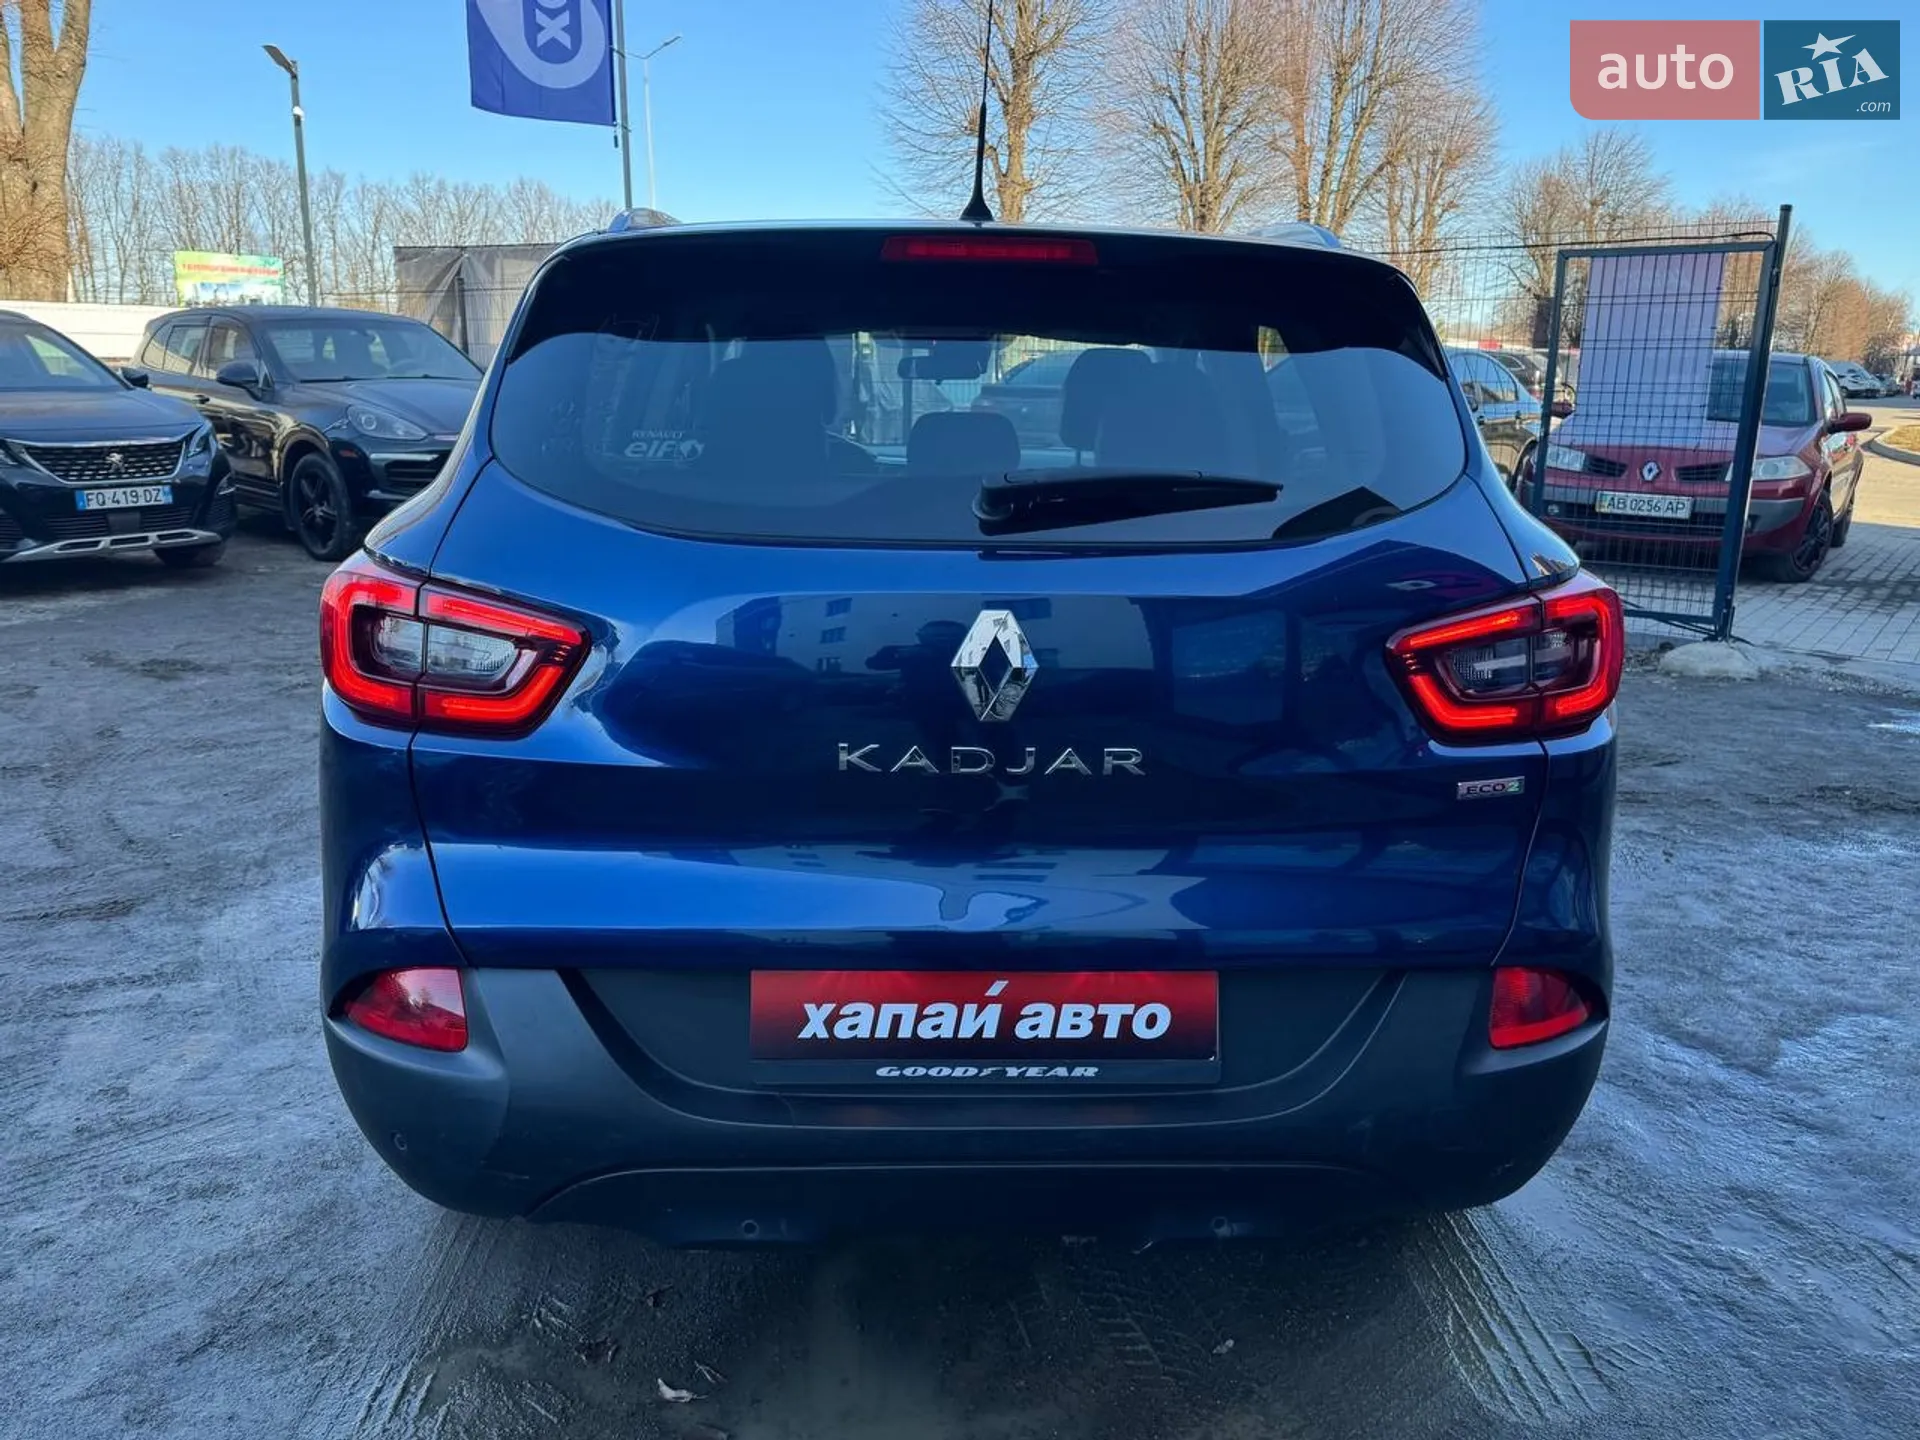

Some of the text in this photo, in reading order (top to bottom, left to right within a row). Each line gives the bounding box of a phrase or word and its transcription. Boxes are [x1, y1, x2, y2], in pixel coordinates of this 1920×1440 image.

[1630, 499, 1662, 513] 0256
[838, 742, 1146, 776] KADJAR
[798, 980, 1173, 1040] хапай авто
